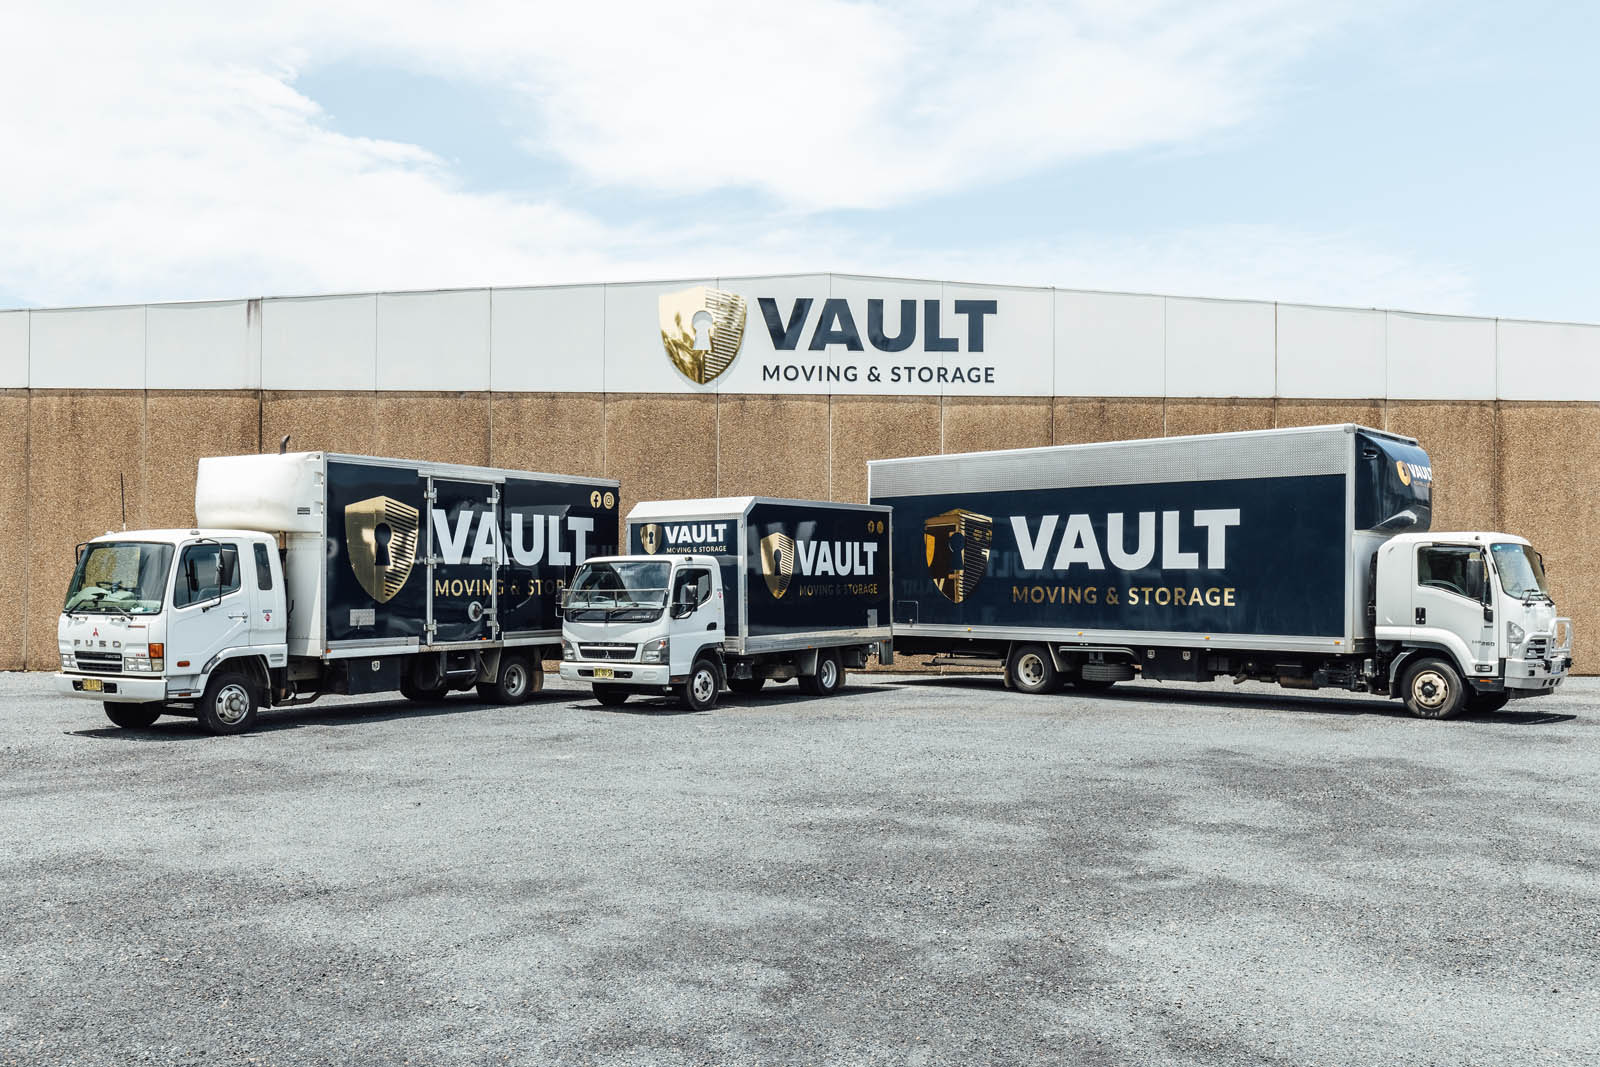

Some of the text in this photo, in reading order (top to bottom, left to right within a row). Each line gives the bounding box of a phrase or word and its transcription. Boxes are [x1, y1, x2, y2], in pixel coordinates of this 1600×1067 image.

[757, 297, 998, 353] VAULT
[763, 364, 995, 384] MOVING & STORAGE
[431, 508, 594, 567] VAULT
[664, 523, 727, 544] VAULT
[1009, 508, 1241, 571] VAULT
[698, 545, 727, 553] STORAGE
[796, 540, 878, 576] VAULT
[435, 579, 504, 597] MOVING
[527, 579, 564, 596] STOR
[799, 583, 834, 596] MOVING
[842, 583, 878, 595] STORAGE
[1012, 585, 1236, 607] MOVING & STORAGE
[74, 639, 122, 648] FUSO
